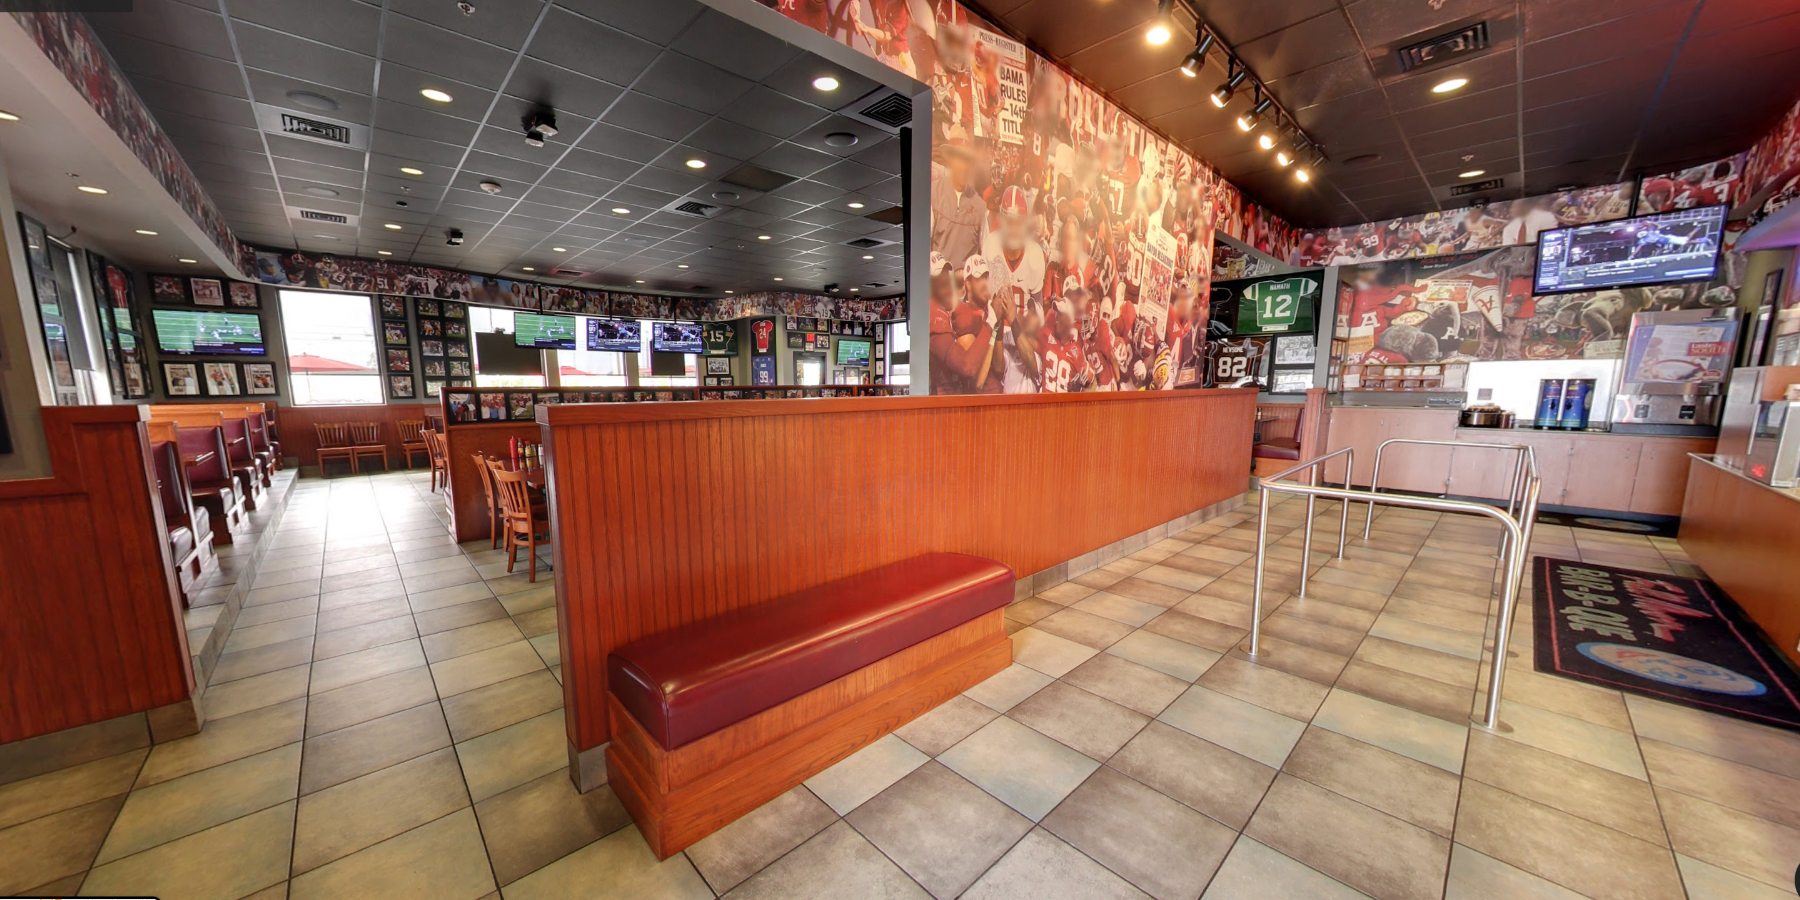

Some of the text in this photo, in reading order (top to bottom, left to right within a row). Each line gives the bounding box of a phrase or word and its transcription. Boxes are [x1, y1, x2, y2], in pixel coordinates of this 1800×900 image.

[1000, 65, 1025, 87] BAMA
[1000, 83, 1027, 104] RULES
[1002, 117, 1022, 135] TITL
[1362, 234, 1379, 249] 99
[1269, 283, 1291, 291] NAMATH
[1263, 294, 1293, 319] 12
[709, 330, 724, 343] 15
[759, 327, 767, 340] 24
[1217, 356, 1247, 378] 82
[759, 370, 769, 383] 99
[1556, 565, 1638, 641] BAR-B-QUE
